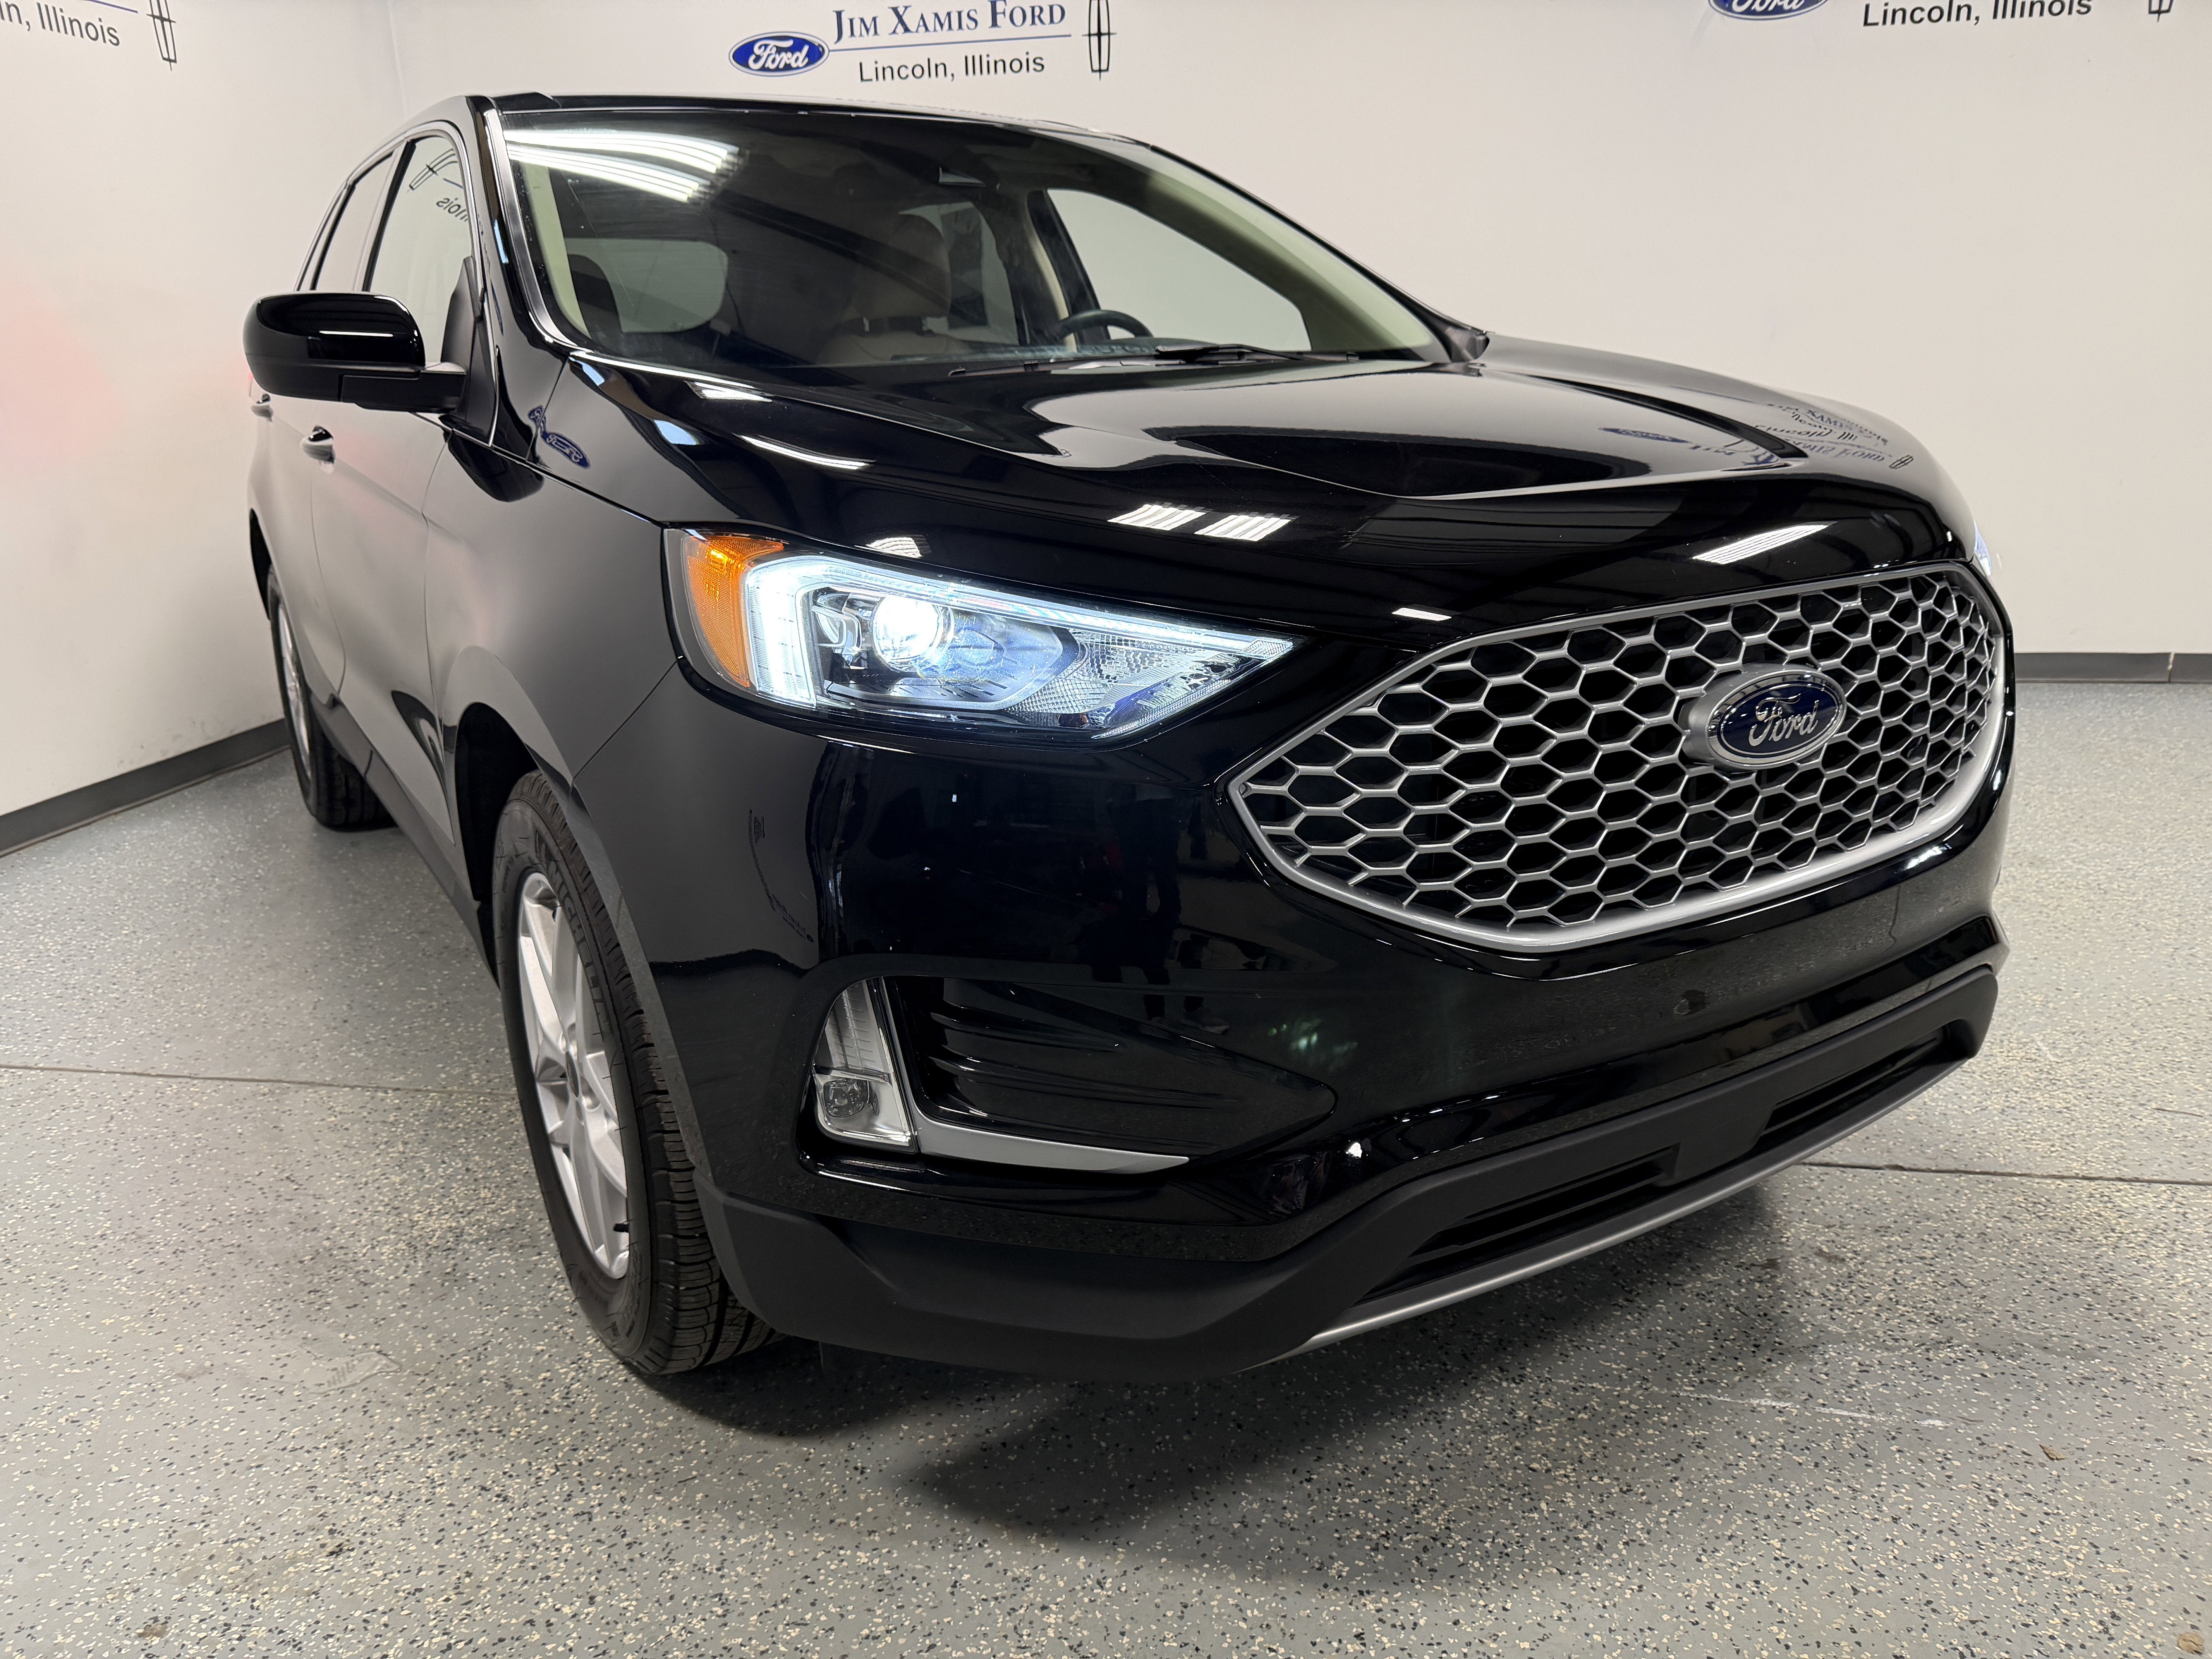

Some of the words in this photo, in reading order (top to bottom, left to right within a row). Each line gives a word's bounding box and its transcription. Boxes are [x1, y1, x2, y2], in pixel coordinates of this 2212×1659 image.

[36, 2, 120, 46] Illinois
[833, 9, 880, 44] JIM
[888, 5, 978, 35] XAMIS
[989, 0, 1065, 28] FORD
[1863, 0, 1980, 26] Lincoln,
[1992, 0, 2092, 19] Illinois
[748, 39, 809, 69] Ford
[859, 57, 954, 82] Lincoln,
[965, 52, 1044, 76] Illinois
[1748, 693, 1819, 747] Ford
[547, 860, 614, 1037] MICHELIN
